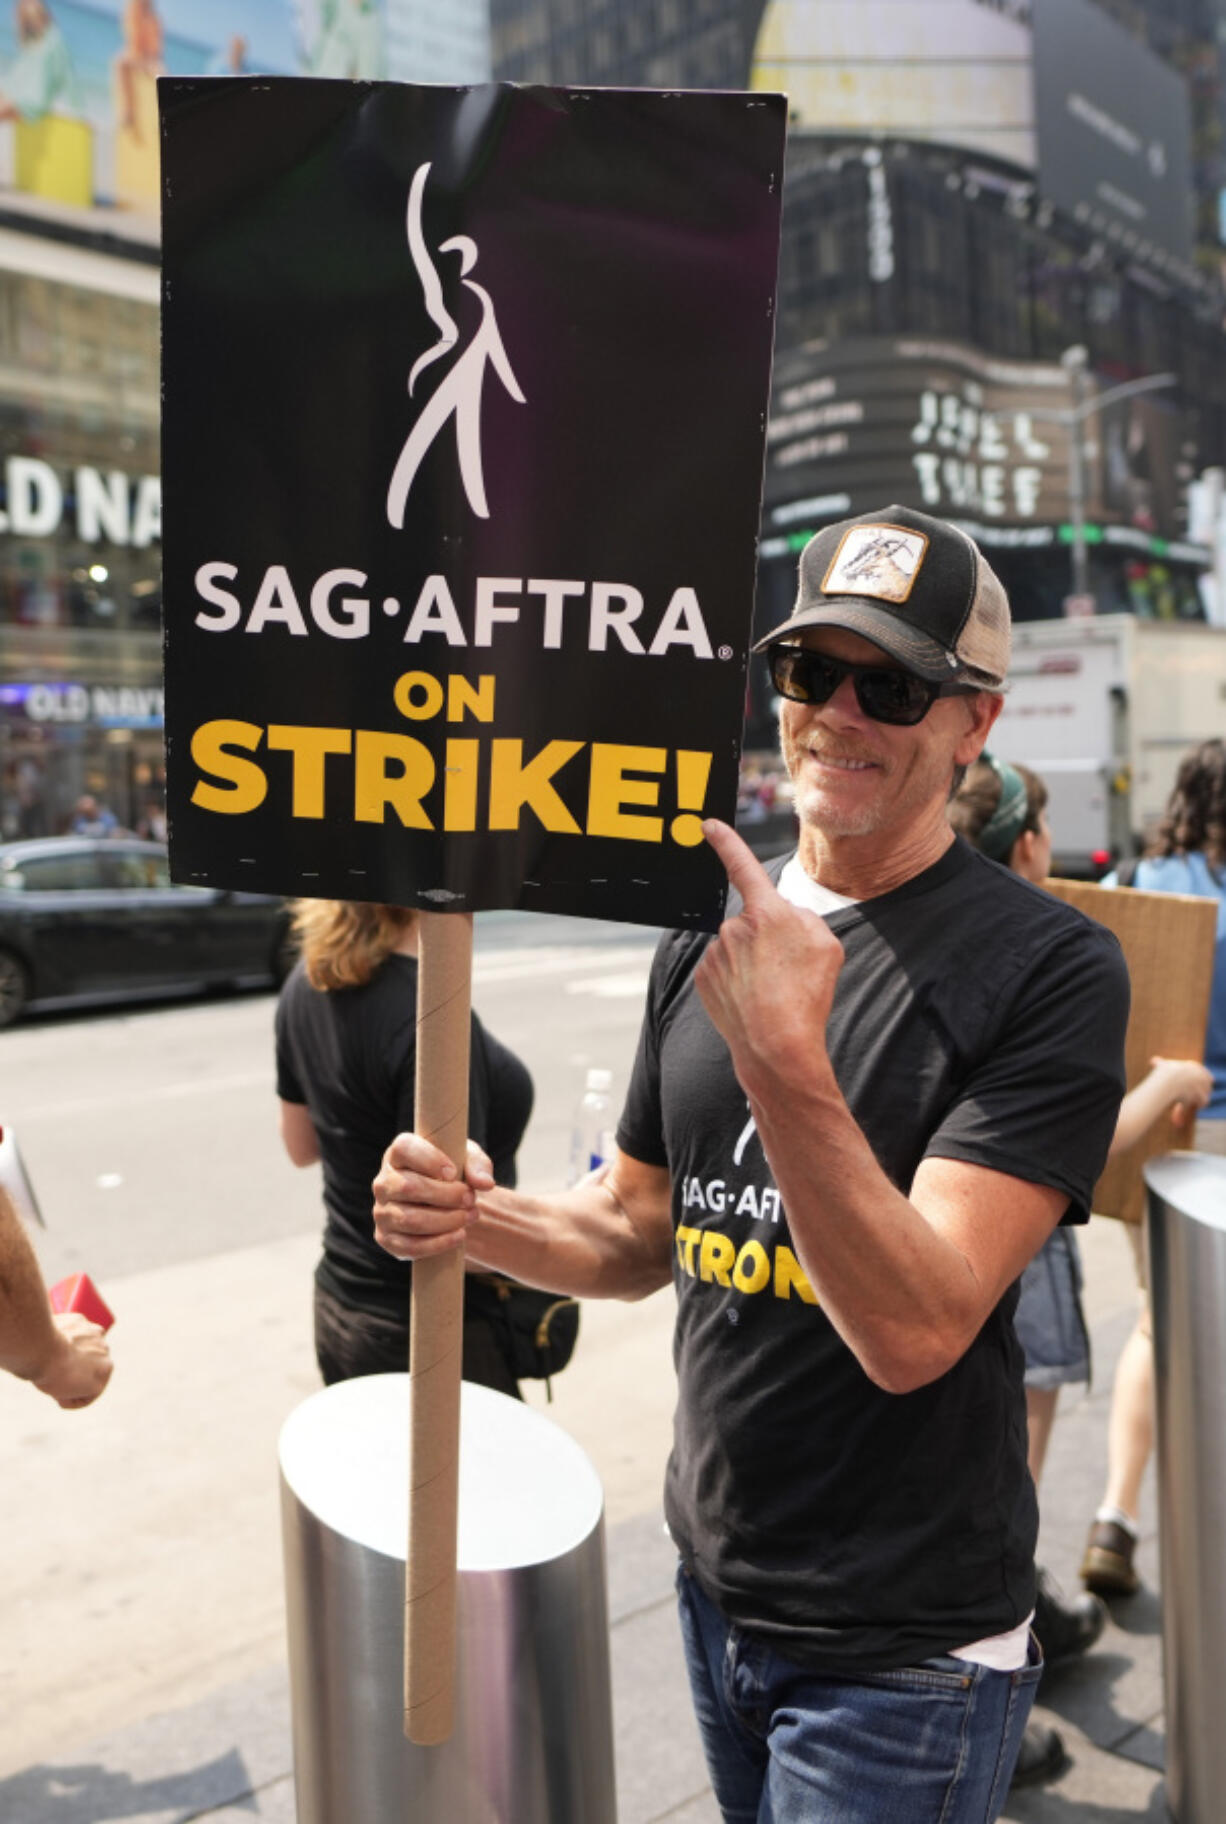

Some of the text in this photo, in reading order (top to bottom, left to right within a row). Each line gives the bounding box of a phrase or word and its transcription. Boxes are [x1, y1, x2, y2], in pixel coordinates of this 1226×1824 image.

[0, 456, 62, 537] D
[26, 684, 89, 723] OLD
[393, 670, 496, 723] ON
[190, 718, 713, 847] STRIKE!
